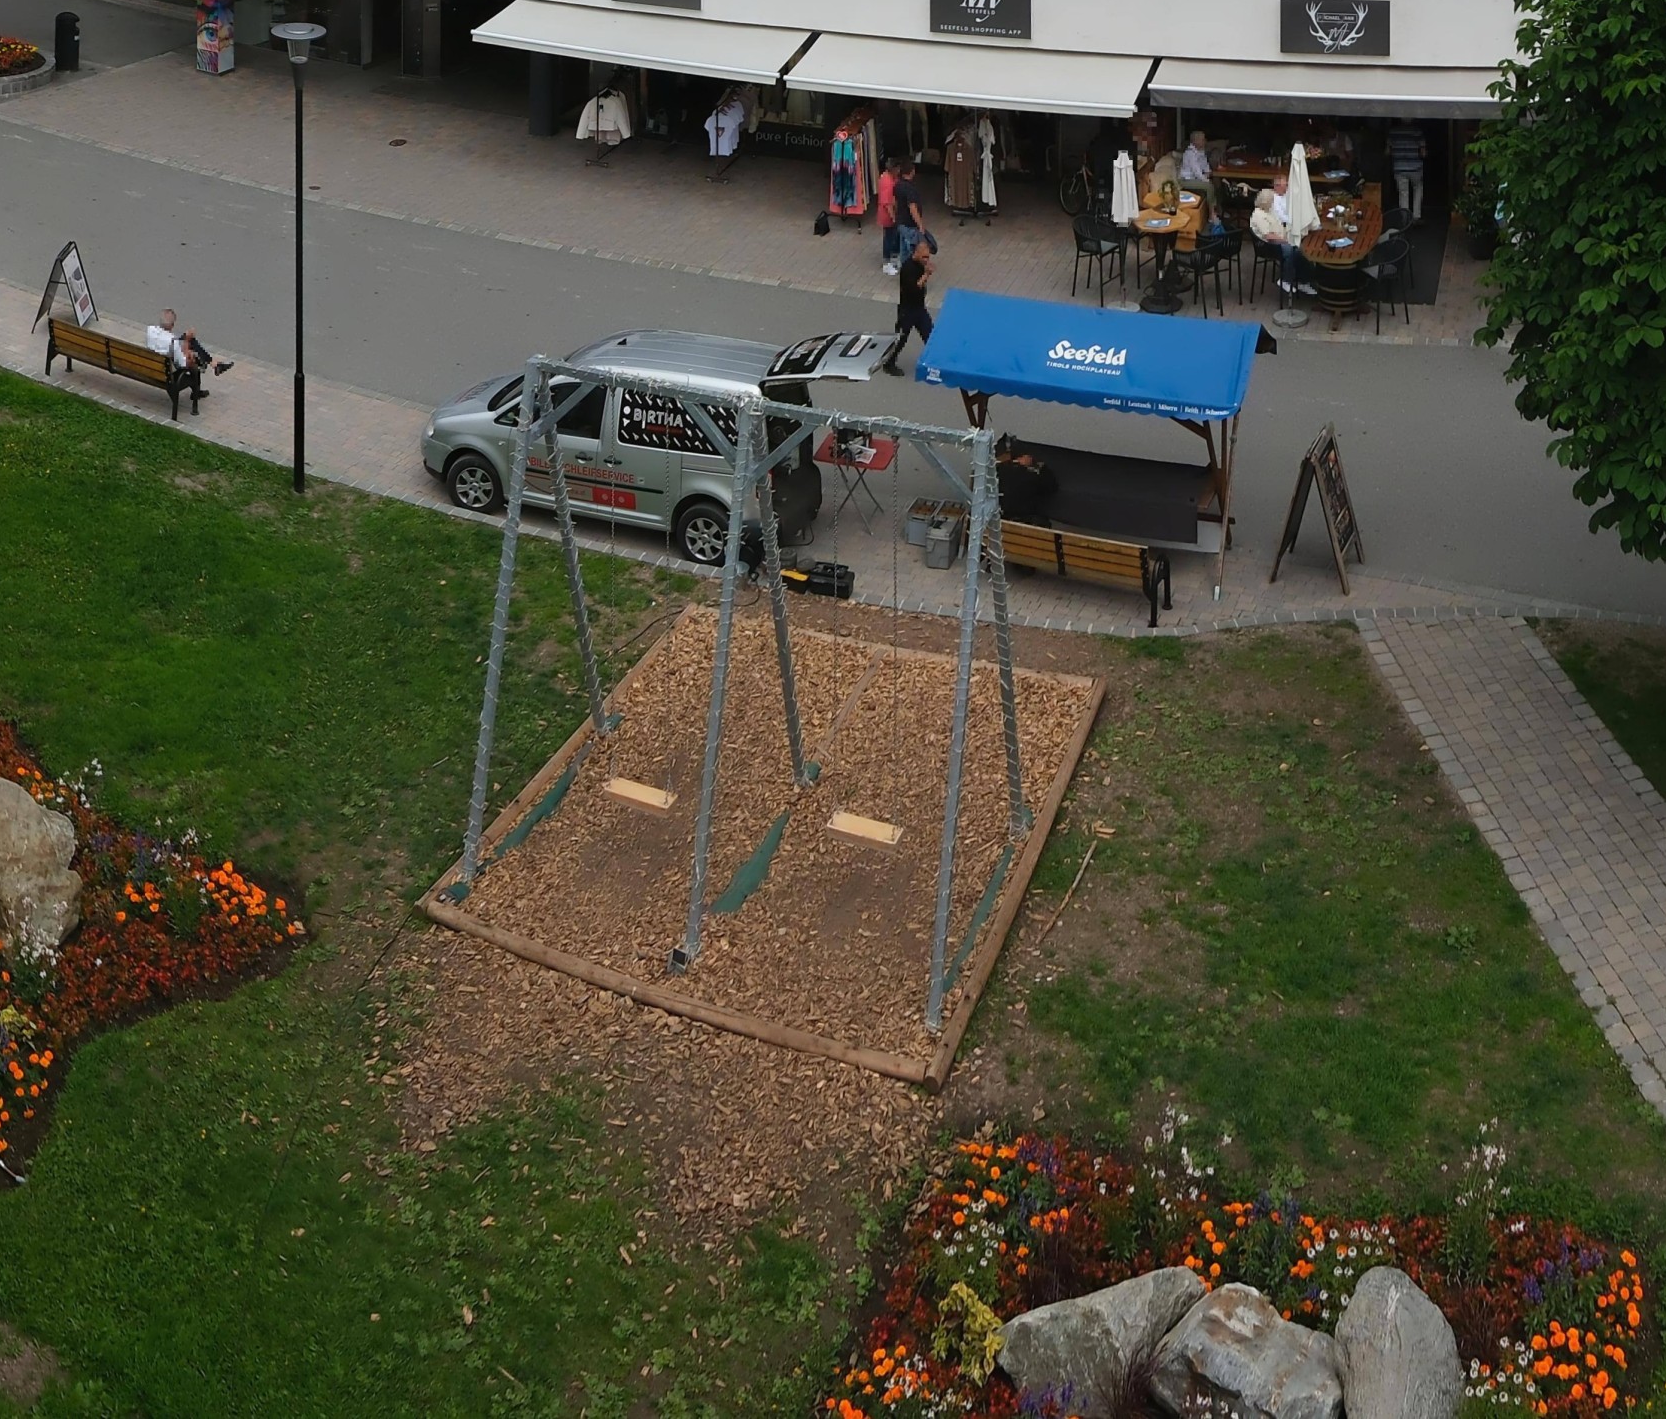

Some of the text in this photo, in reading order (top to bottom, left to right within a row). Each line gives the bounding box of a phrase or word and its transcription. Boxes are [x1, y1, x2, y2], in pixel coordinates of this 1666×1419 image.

[940, 24, 969, 32] SEEFELD
[755, 130, 781, 145] pure
[1048, 340, 1127, 366] Seefeld
[1046, 360, 1121, 376] TIROLS HOCHPLATEAU
[633, 407, 683, 429] BIRTHA
[563, 463, 635, 484] CHLEIFSERVICE
